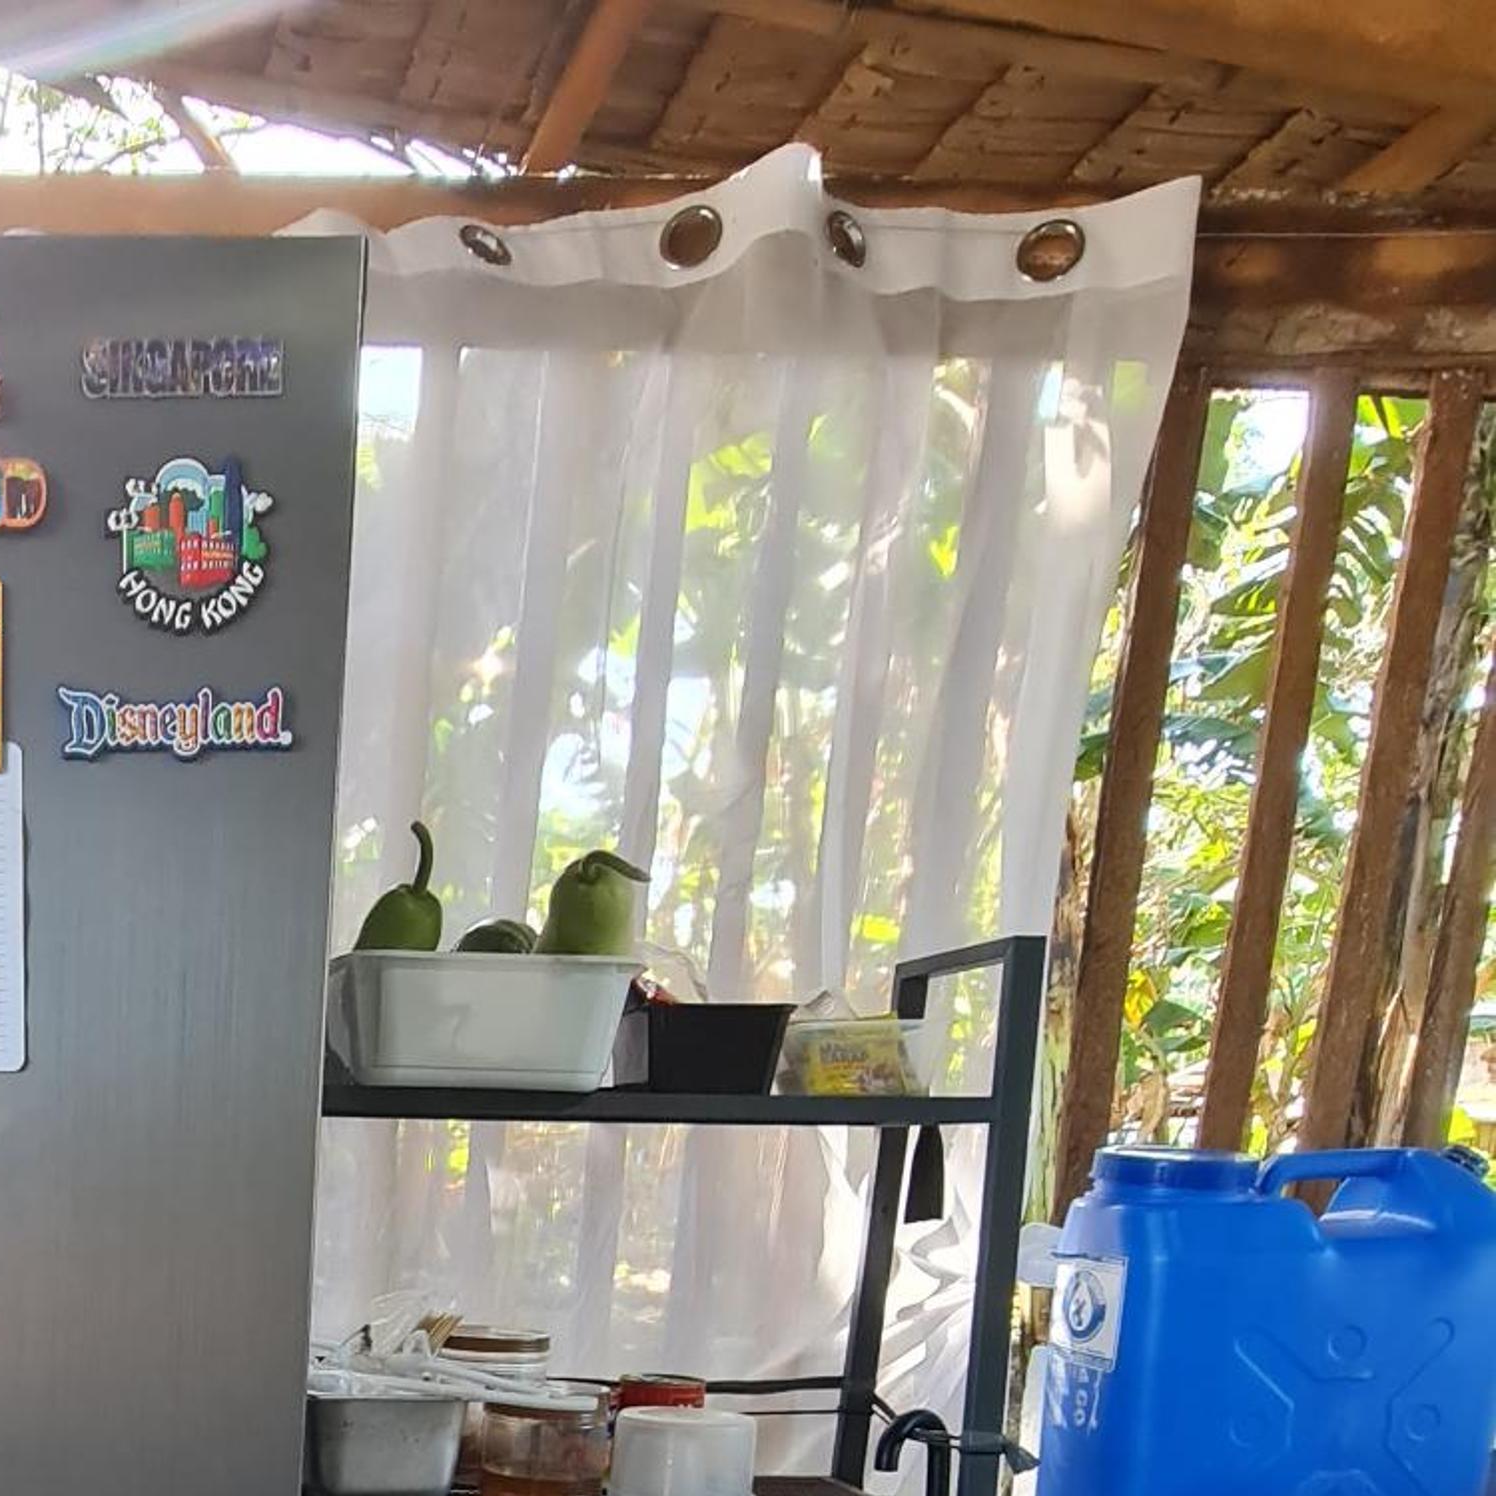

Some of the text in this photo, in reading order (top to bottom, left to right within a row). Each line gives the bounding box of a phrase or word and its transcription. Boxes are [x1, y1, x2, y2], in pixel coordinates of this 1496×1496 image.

[119, 560, 275, 630] HONG KONG
[58, 688, 290, 757] Disneyland
